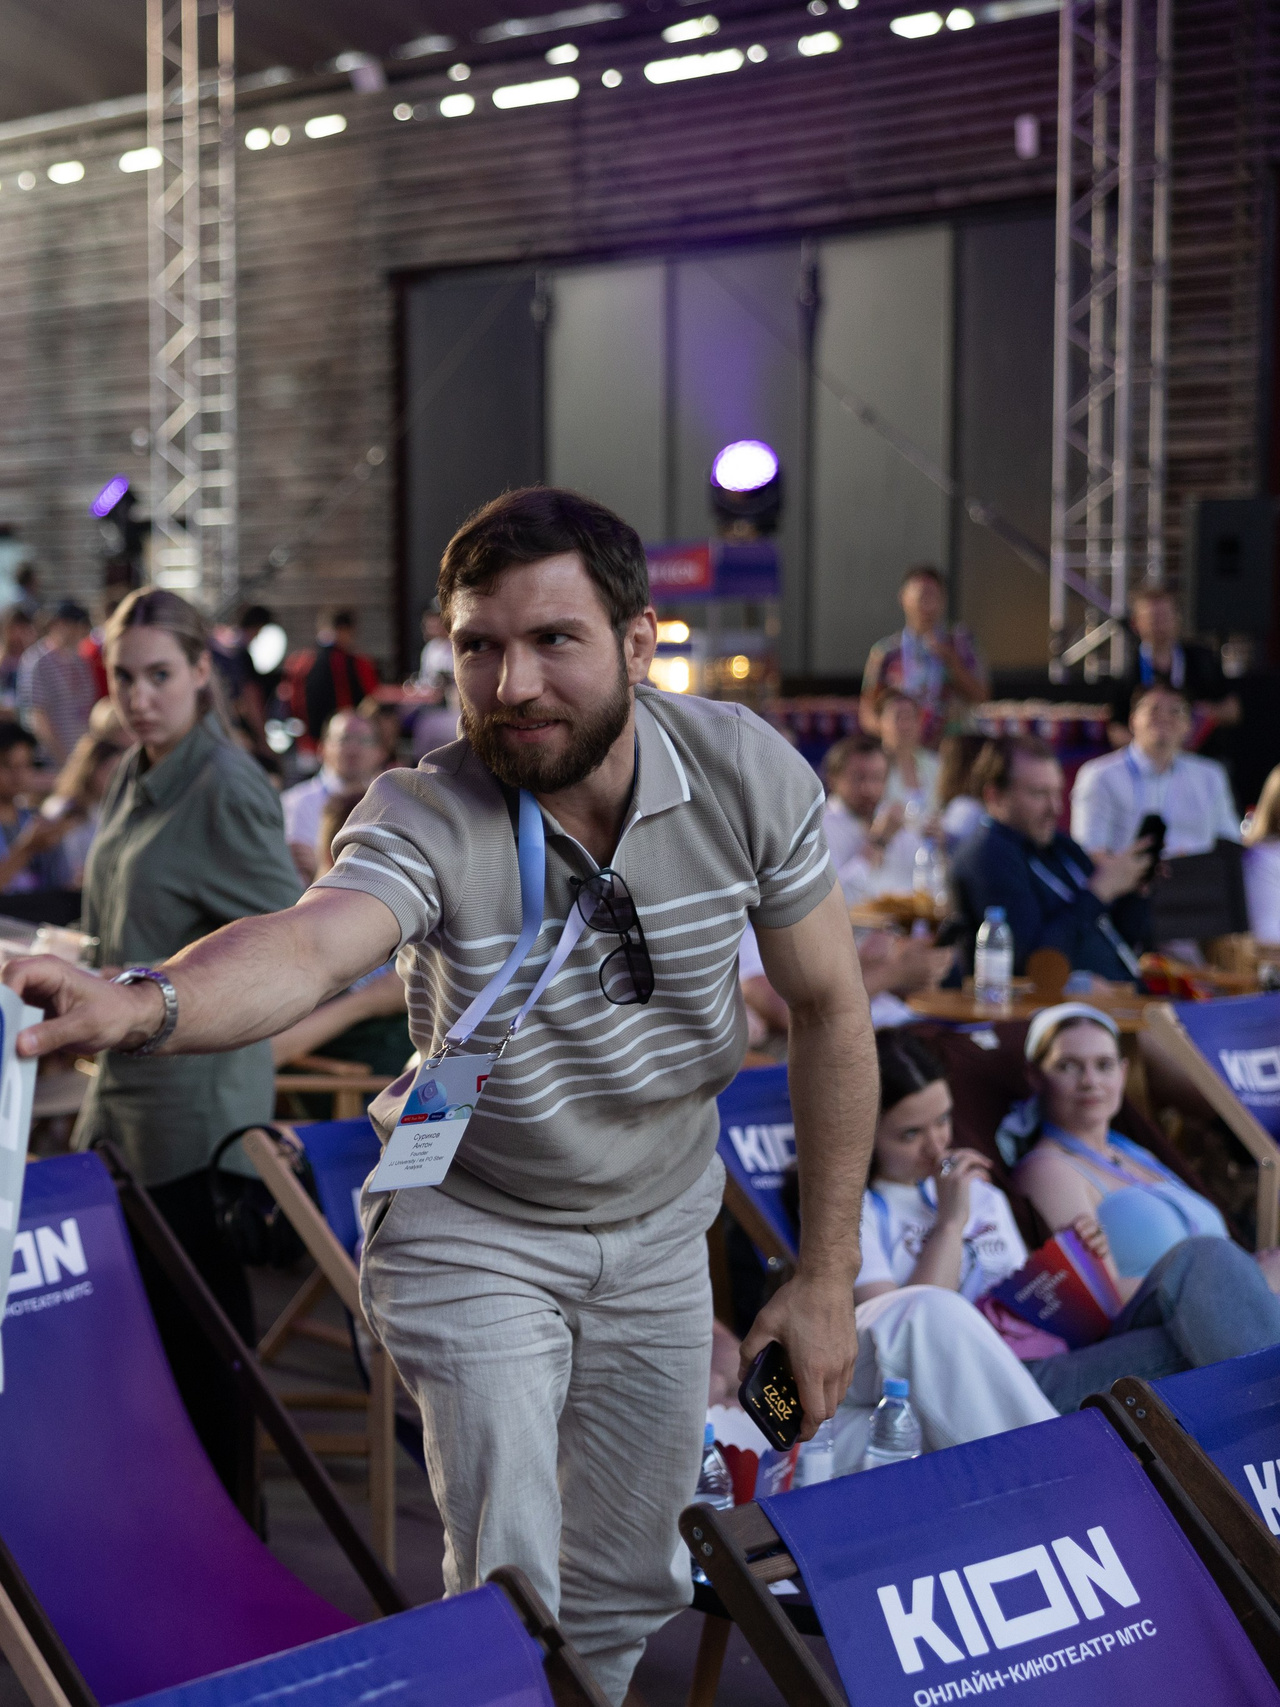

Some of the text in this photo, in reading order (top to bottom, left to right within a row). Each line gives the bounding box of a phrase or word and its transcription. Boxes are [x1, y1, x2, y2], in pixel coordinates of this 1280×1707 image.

[1218, 1046, 1280, 1092] KIO
[413, 1132, 441, 1142] Суриков
[763, 1384, 793, 1420] 20:27
[876, 1525, 1141, 1675] KION
[913, 1619, 1157, 1707] ОНЛАЙН-КИНОТЕАТР МТС
